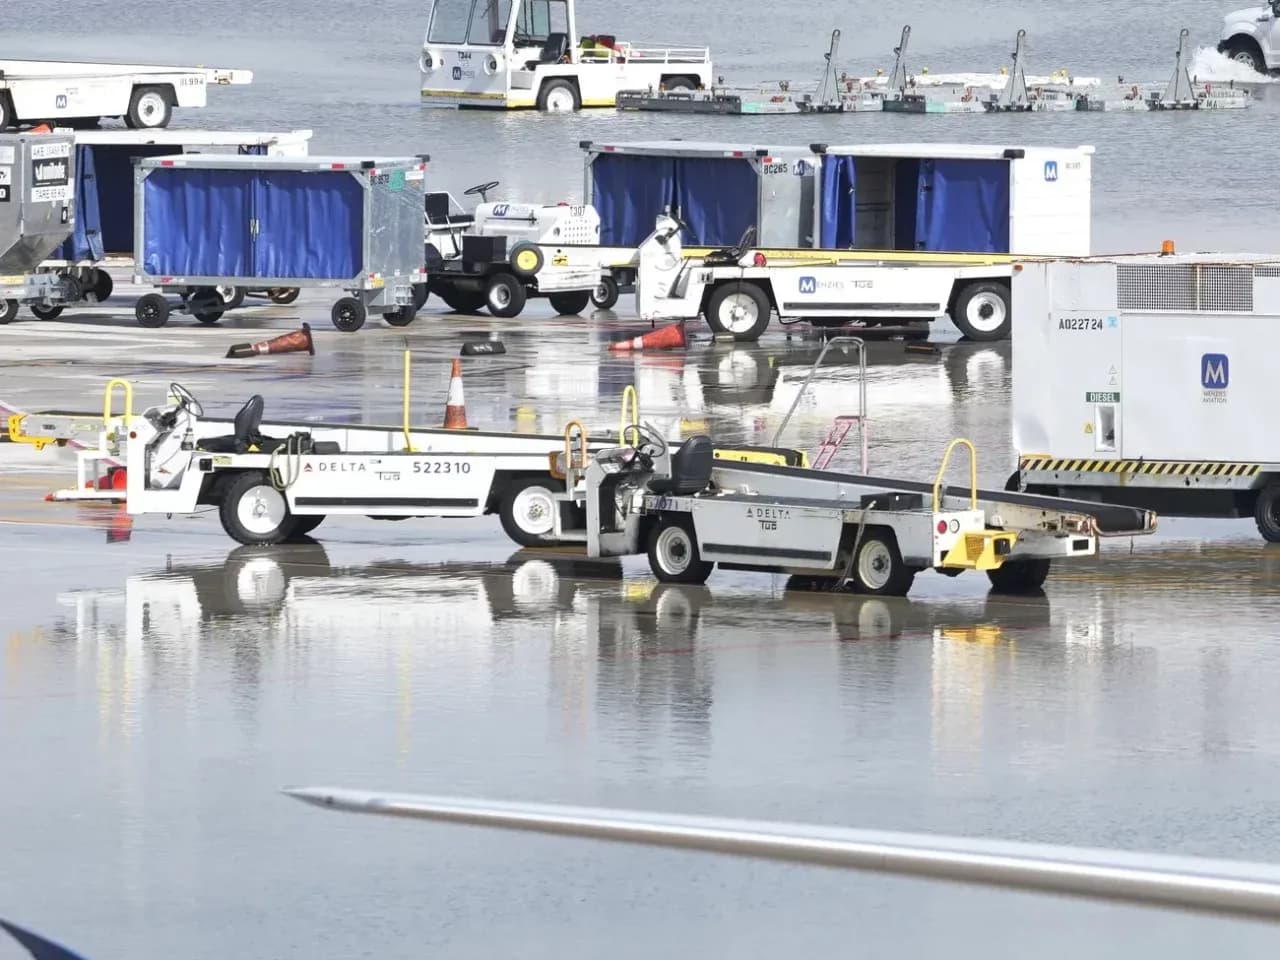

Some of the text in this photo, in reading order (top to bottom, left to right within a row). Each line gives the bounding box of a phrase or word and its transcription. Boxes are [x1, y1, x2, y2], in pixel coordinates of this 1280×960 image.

[1204, 359, 1226, 384] M
[1090, 392, 1115, 402] DIESEL
[319, 461, 472, 474] DELTA 522310
[756, 508, 792, 520] DELTA
